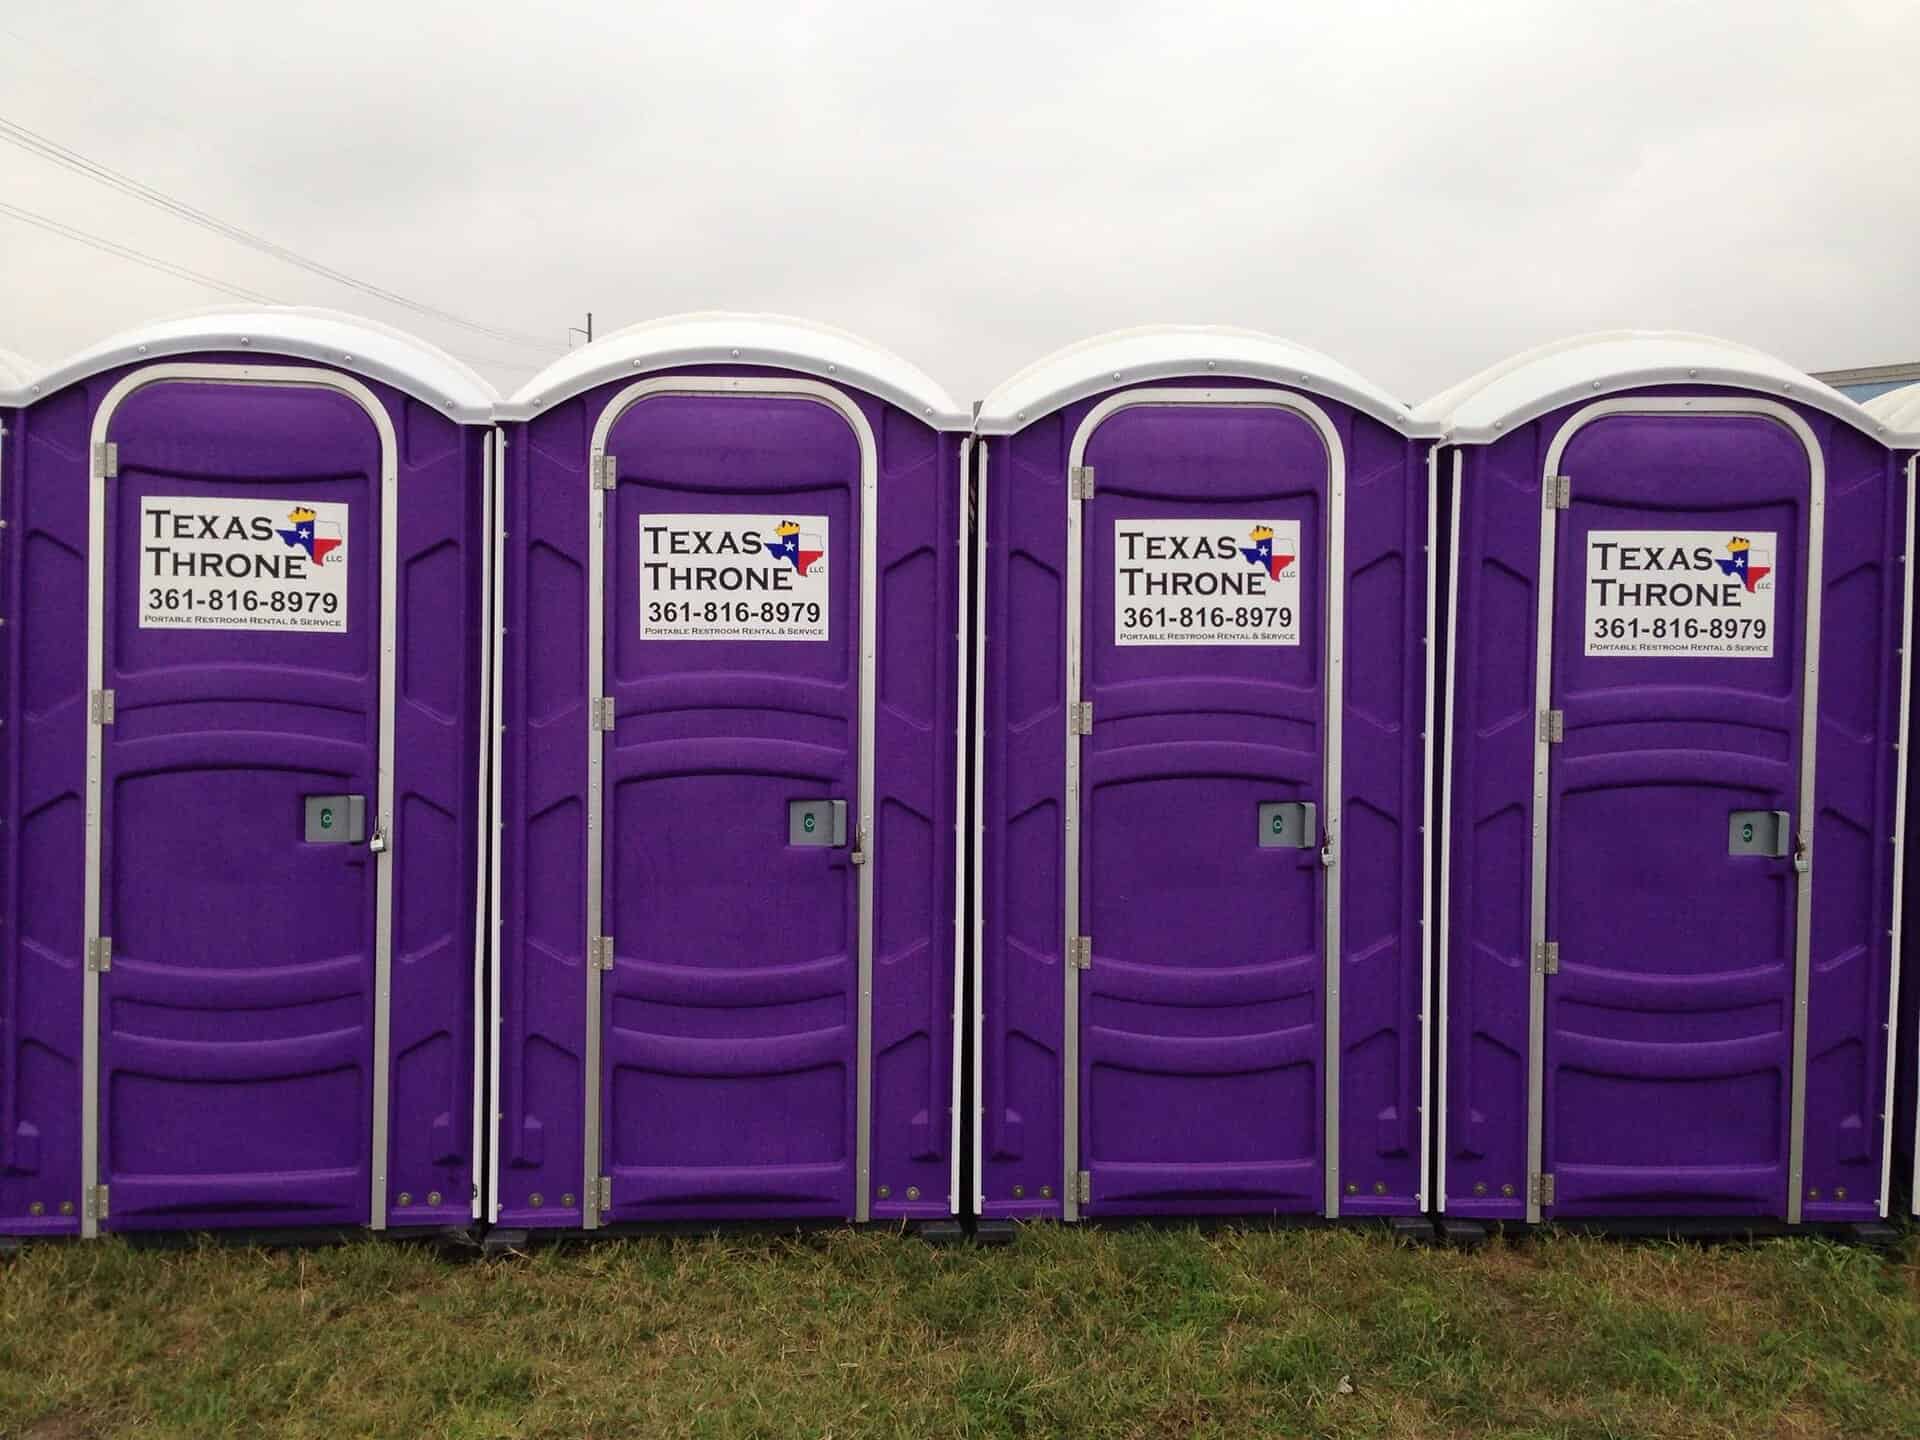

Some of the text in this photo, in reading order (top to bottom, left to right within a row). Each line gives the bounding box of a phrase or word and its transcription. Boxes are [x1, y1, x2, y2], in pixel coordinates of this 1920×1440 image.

[145, 509, 273, 541] TEXAS
[644, 526, 762, 555] TEXAS
[1119, 531, 1237, 560] TEXAS
[145, 546, 307, 580] THRONE
[326, 555, 343, 563] LLC
[1591, 542, 1713, 571] TEXAS
[644, 562, 793, 591] THRONE
[809, 566, 824, 574] LLC
[1119, 567, 1266, 596] THRONE
[148, 588, 338, 614] 361-816-8979
[1591, 578, 1742, 607] THRONE
[144, 615, 341, 627] PORTABLE RESTROOM RENTAL & SERVICE
[648, 601, 821, 623] 361-816-8979
[1123, 607, 1292, 628] 361-816-8979
[787, 628, 823, 636] SERVICE
[1119, 633, 1166, 641] PORTABLE
[1216, 632, 1250, 640] RENTAL
[1252, 632, 1259, 640] &
[1594, 617, 1766, 639] 361-816-8979
[1589, 643, 1769, 652] PORTABLE RESTROOM RENTAL & SERVICE
